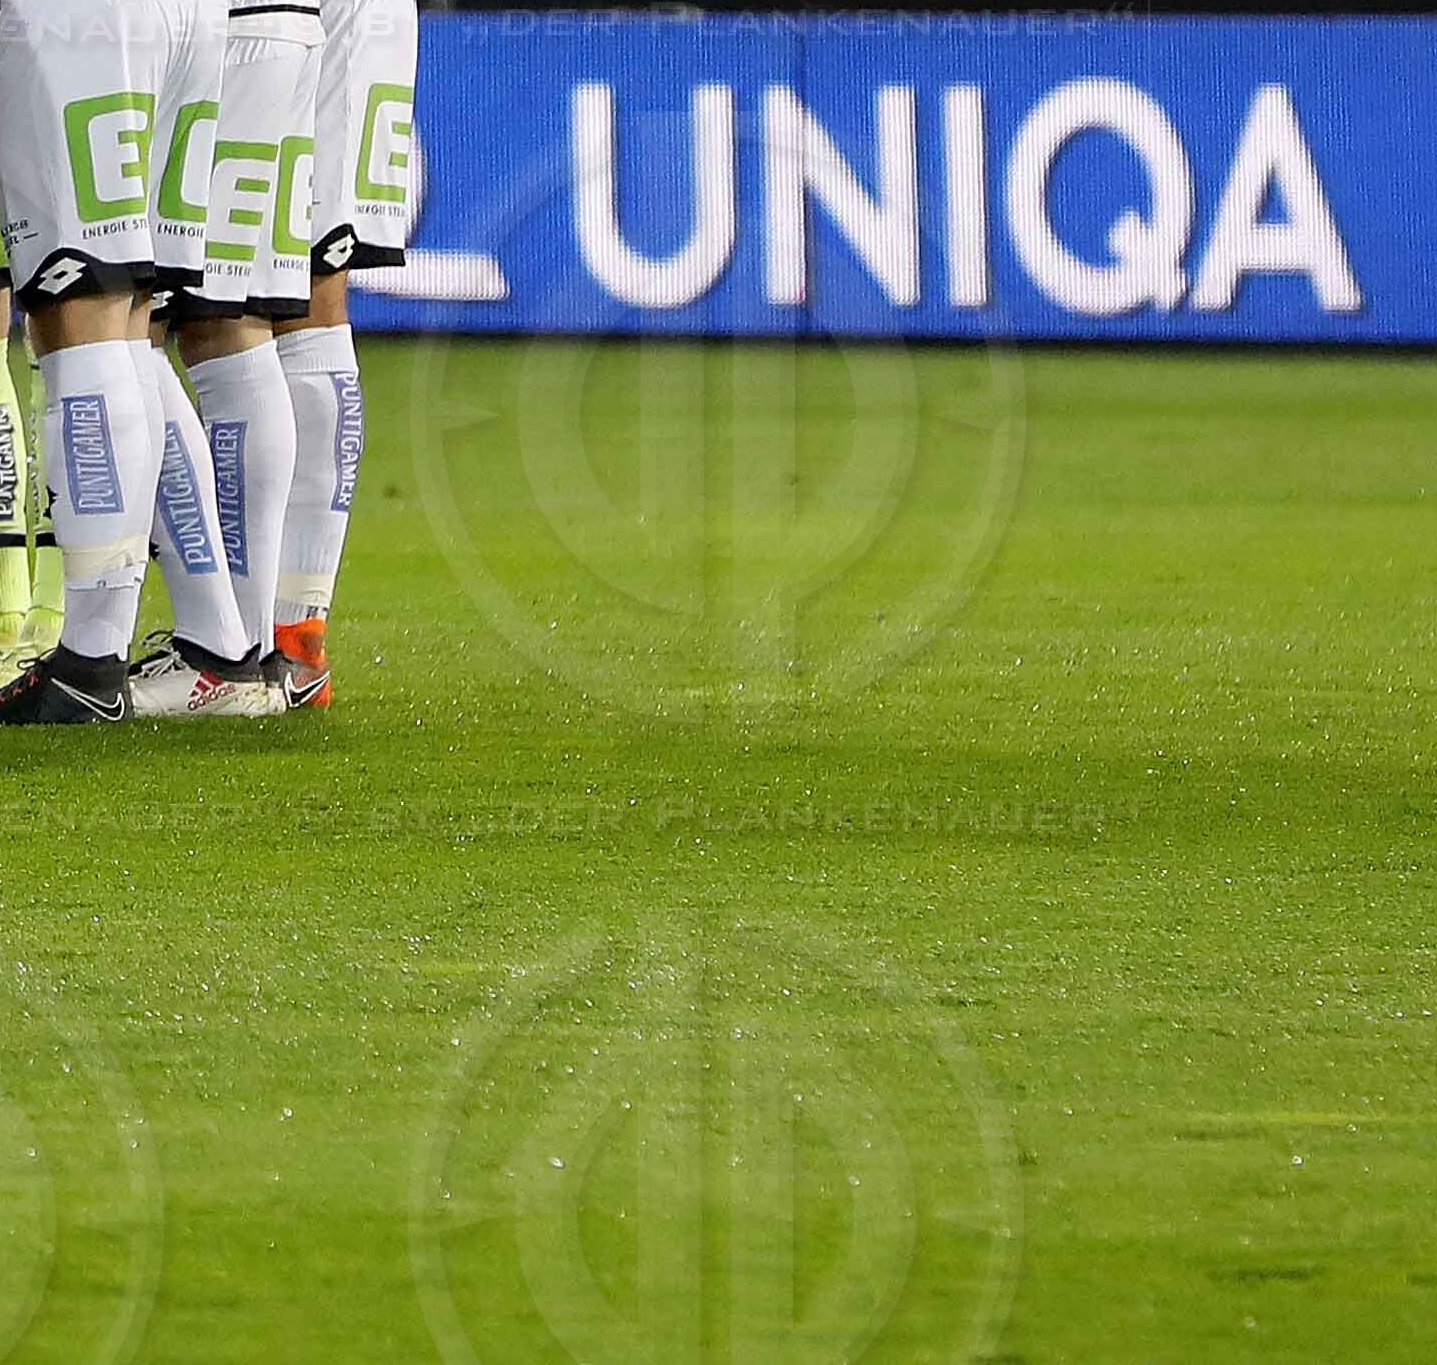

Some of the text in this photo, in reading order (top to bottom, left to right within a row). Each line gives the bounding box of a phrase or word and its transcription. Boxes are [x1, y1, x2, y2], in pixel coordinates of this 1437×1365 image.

[82, 221, 131, 240] ENERGIE
[569, 74, 1362, 315] UNIQA
[73, 399, 118, 512] PUNTIGAMER
